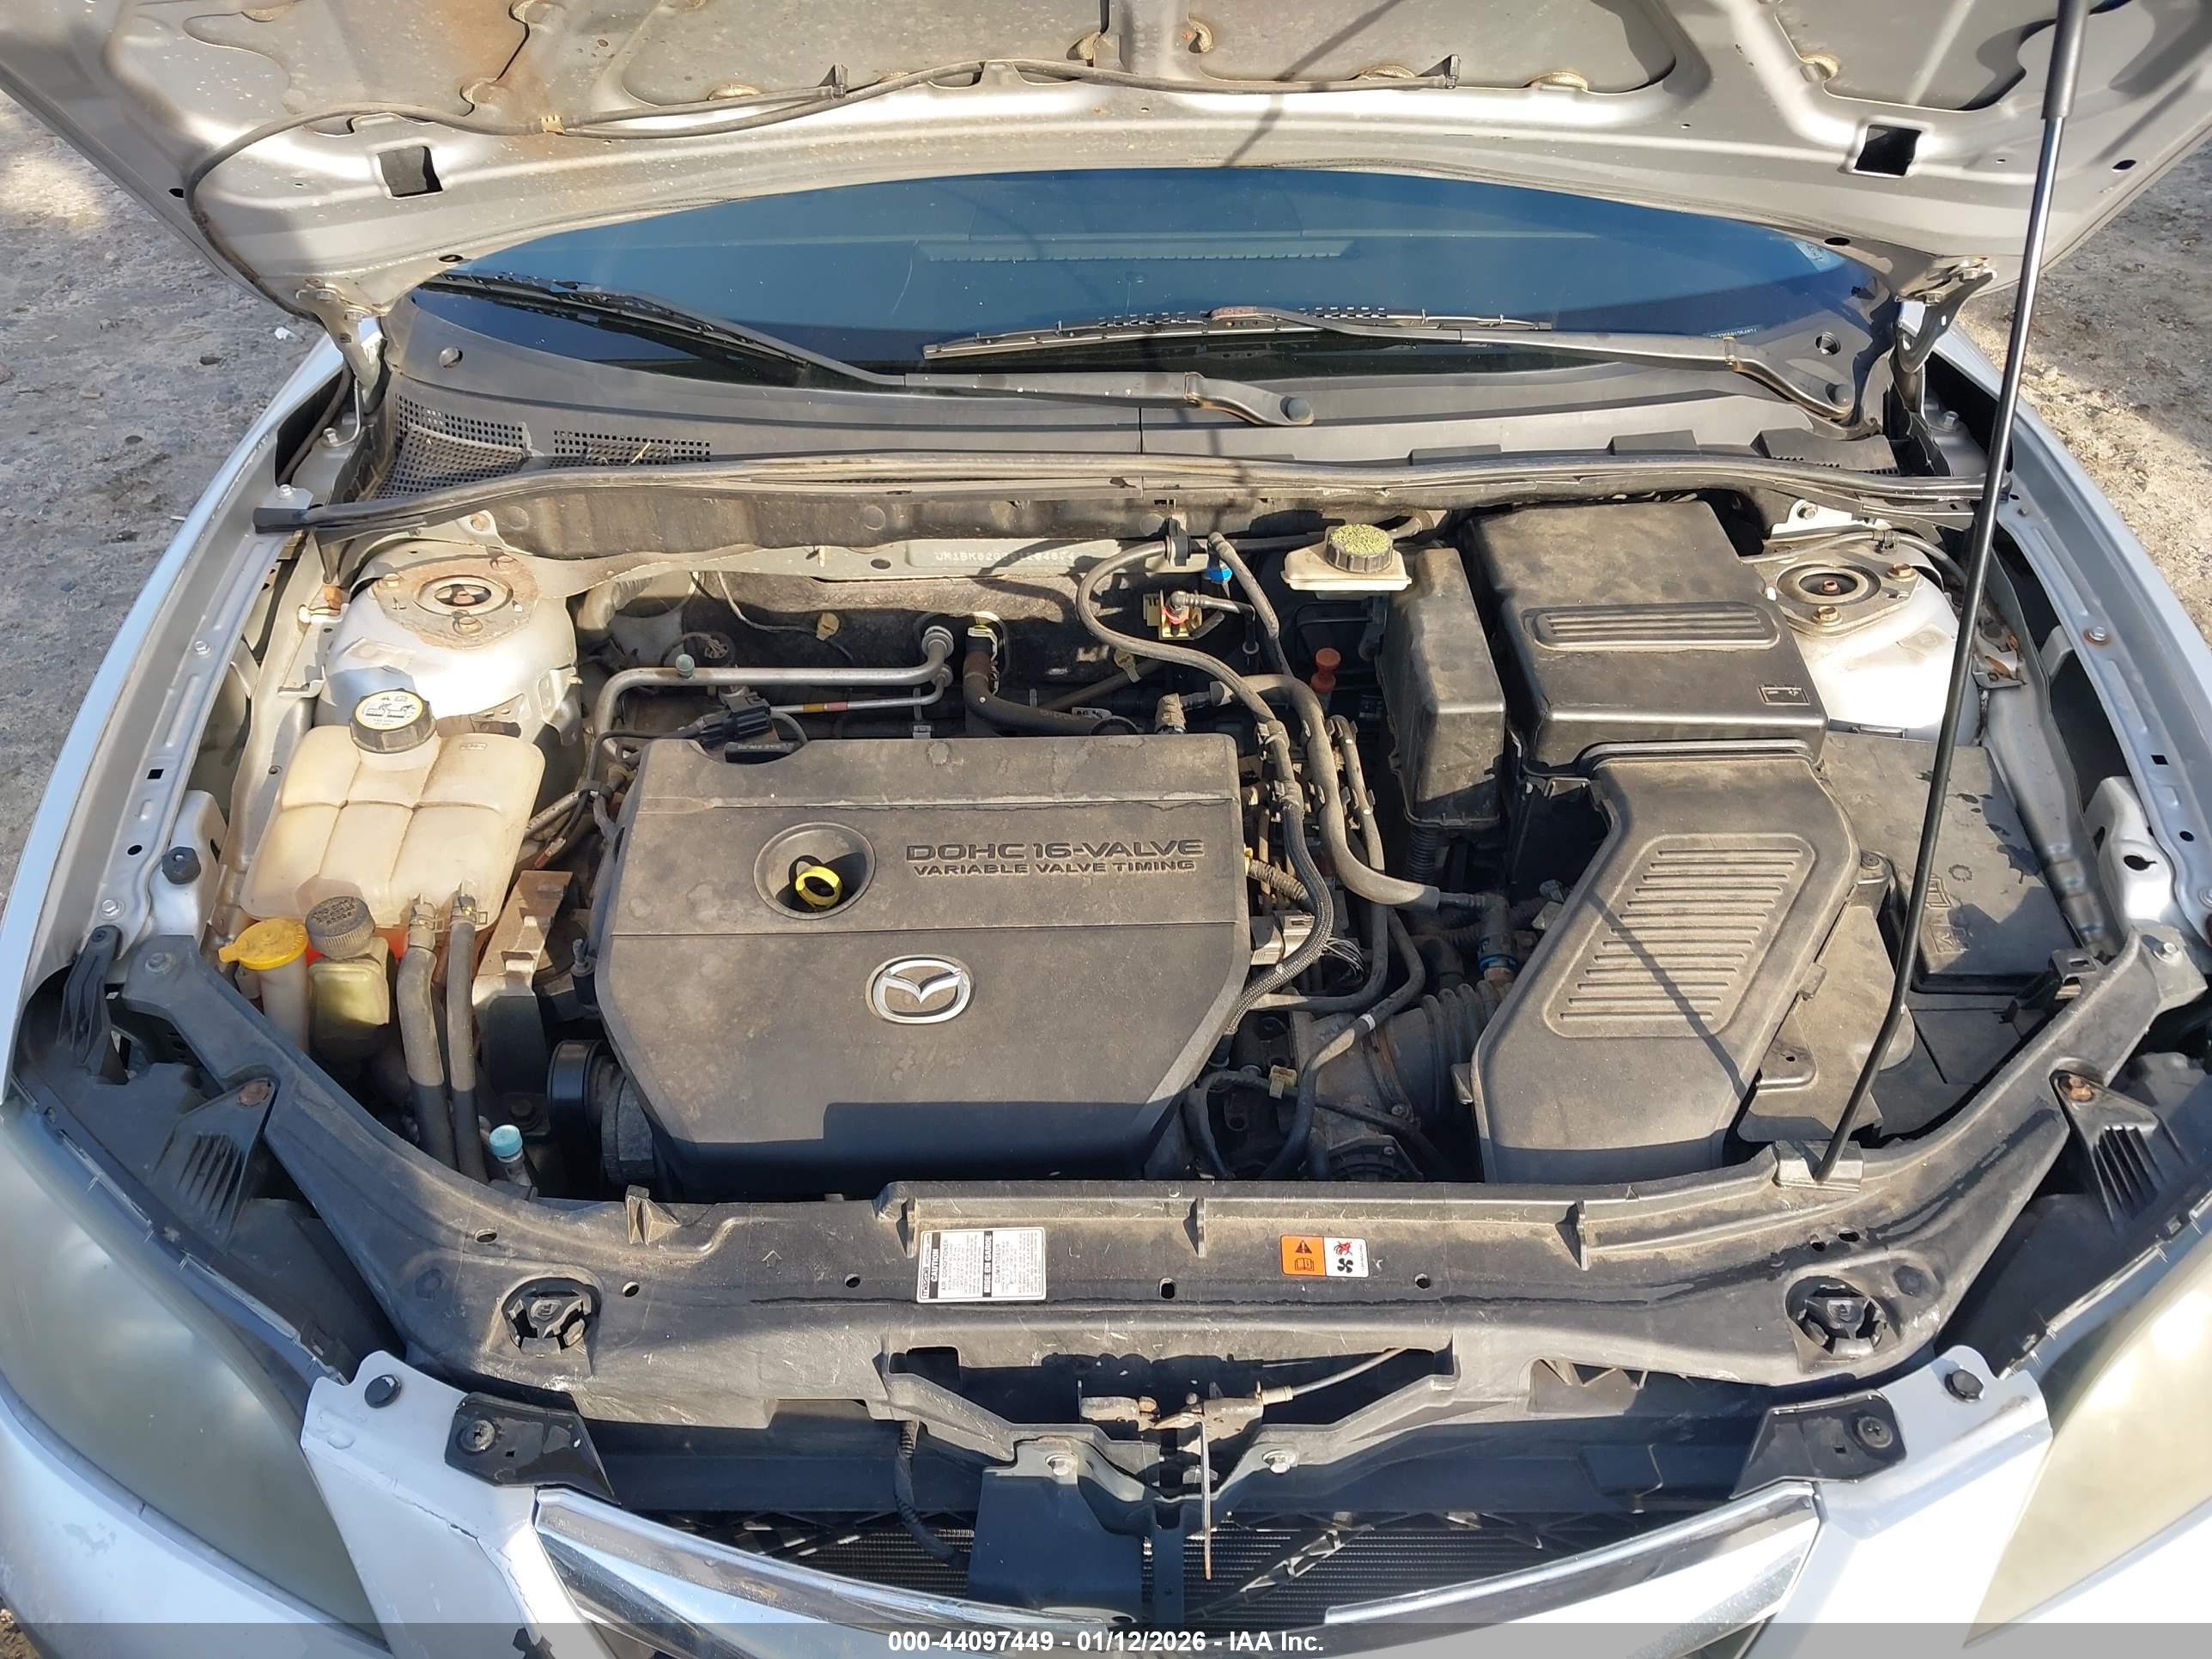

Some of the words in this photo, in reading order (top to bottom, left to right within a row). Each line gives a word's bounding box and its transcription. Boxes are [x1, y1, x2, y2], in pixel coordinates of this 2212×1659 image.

[906, 844, 1027, 860] DOHC
[1033, 839, 1204, 859] 16-VALVE
[914, 864, 1029, 876] VARIABLE
[1036, 862, 1107, 873] VALVE
[1113, 860, 1195, 872] TIMING
[984, 1234, 993, 1261] GARDE
